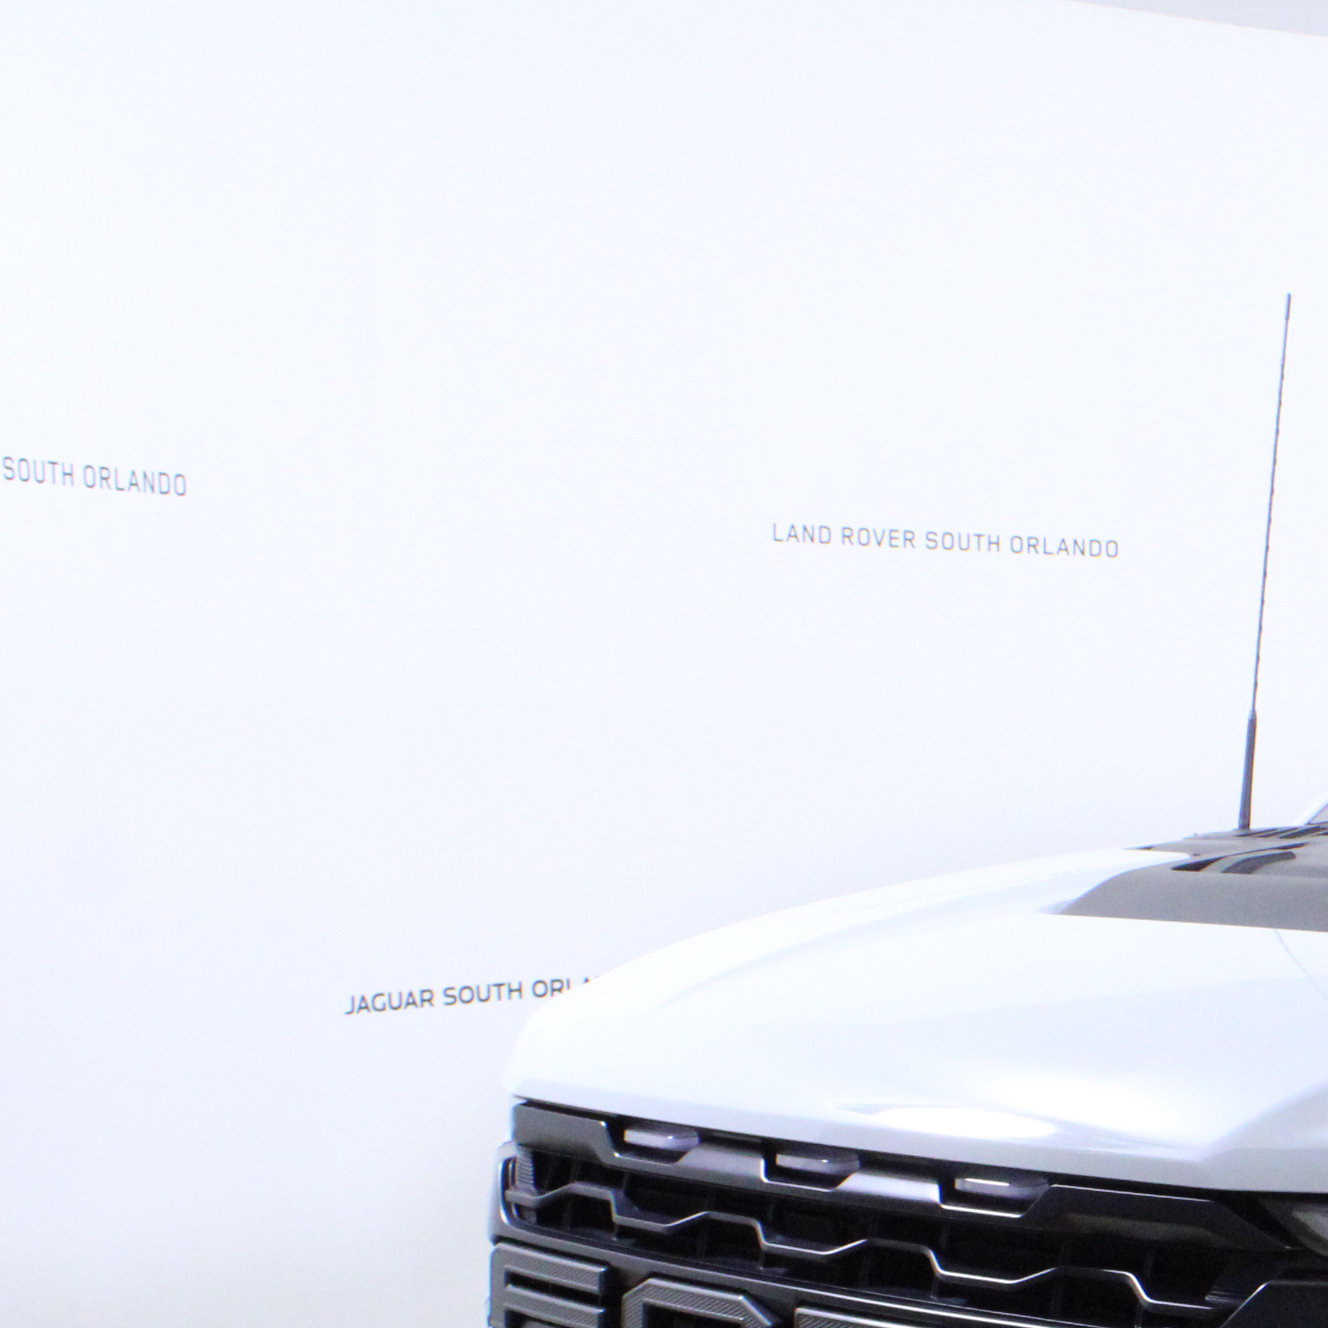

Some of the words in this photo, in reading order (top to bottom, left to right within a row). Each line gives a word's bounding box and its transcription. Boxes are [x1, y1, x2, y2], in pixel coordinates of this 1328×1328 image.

[2, 455, 74, 487] SOUTH
[82, 464, 187, 497] ORLANDO
[772, 522, 832, 545] LAND
[841, 526, 916, 549] ROVER
[925, 530, 1001, 552] SOUTH
[1010, 535, 1119, 558] ORLANDO
[344, 988, 435, 1015] JAGUAR
[442, 981, 523, 1006] SOUTH
